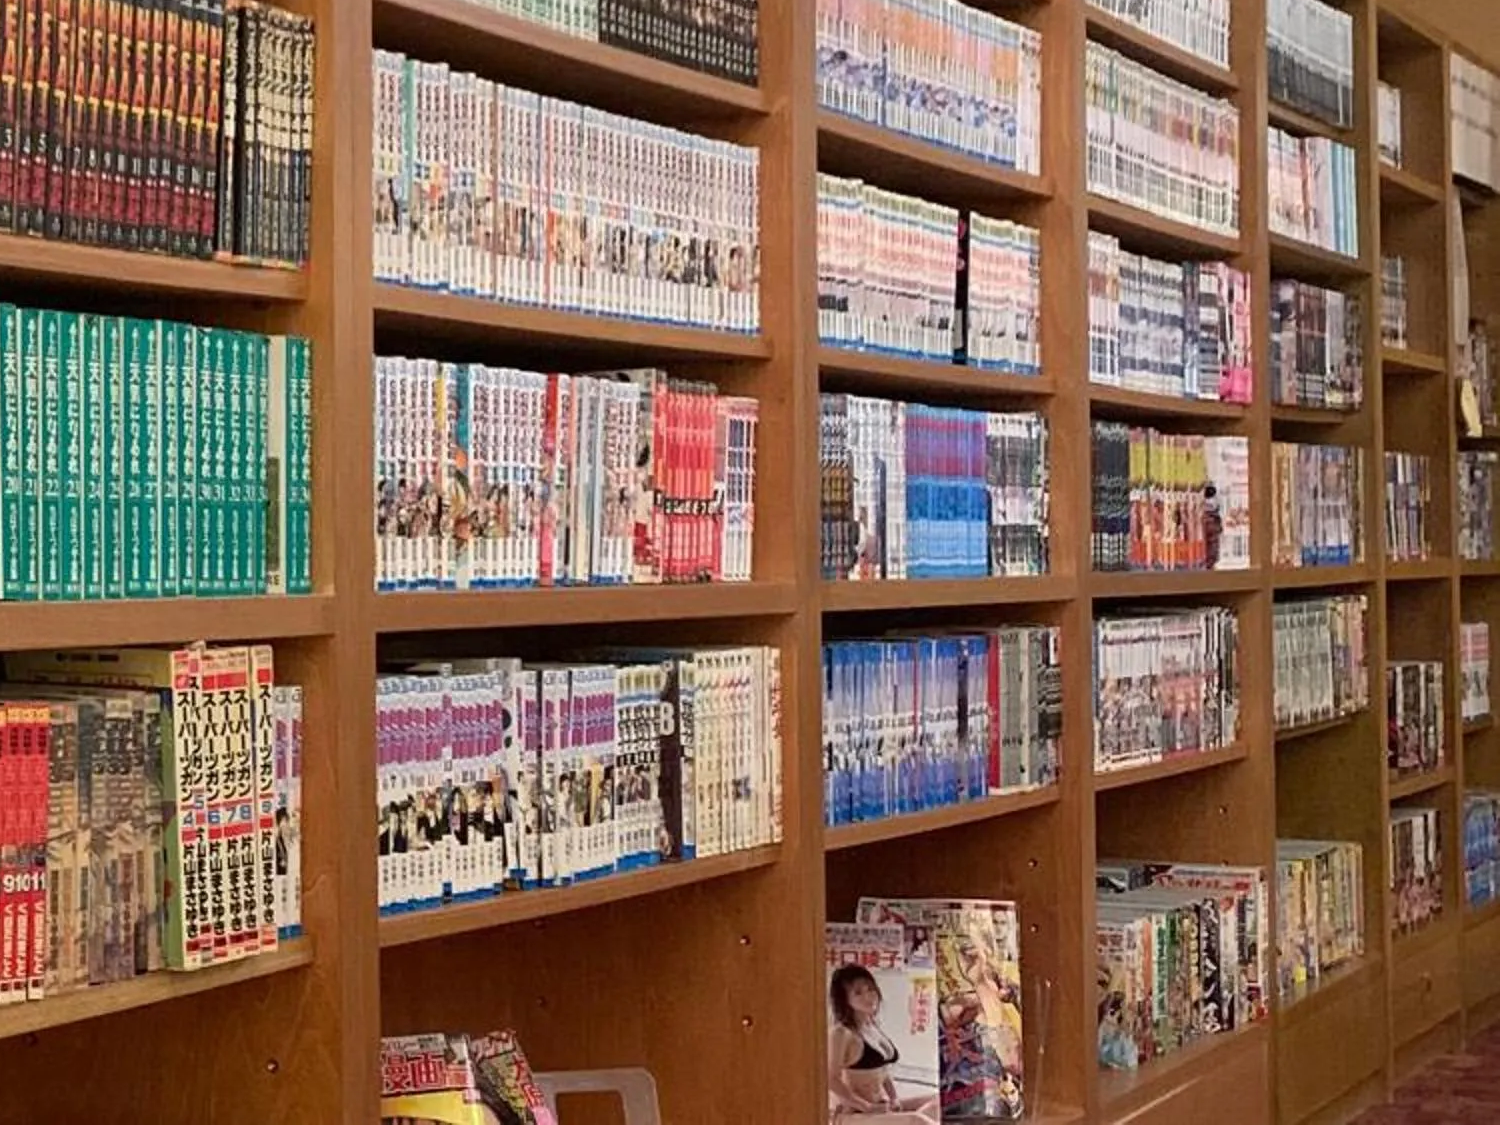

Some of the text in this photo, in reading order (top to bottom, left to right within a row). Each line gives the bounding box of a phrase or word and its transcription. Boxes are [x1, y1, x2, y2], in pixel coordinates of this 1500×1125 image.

[132, 7, 150, 145] HEAT
[206, 26, 223, 156] HEAT
[3, 875, 15, 893] 9
[15, 874, 30, 892] 10
